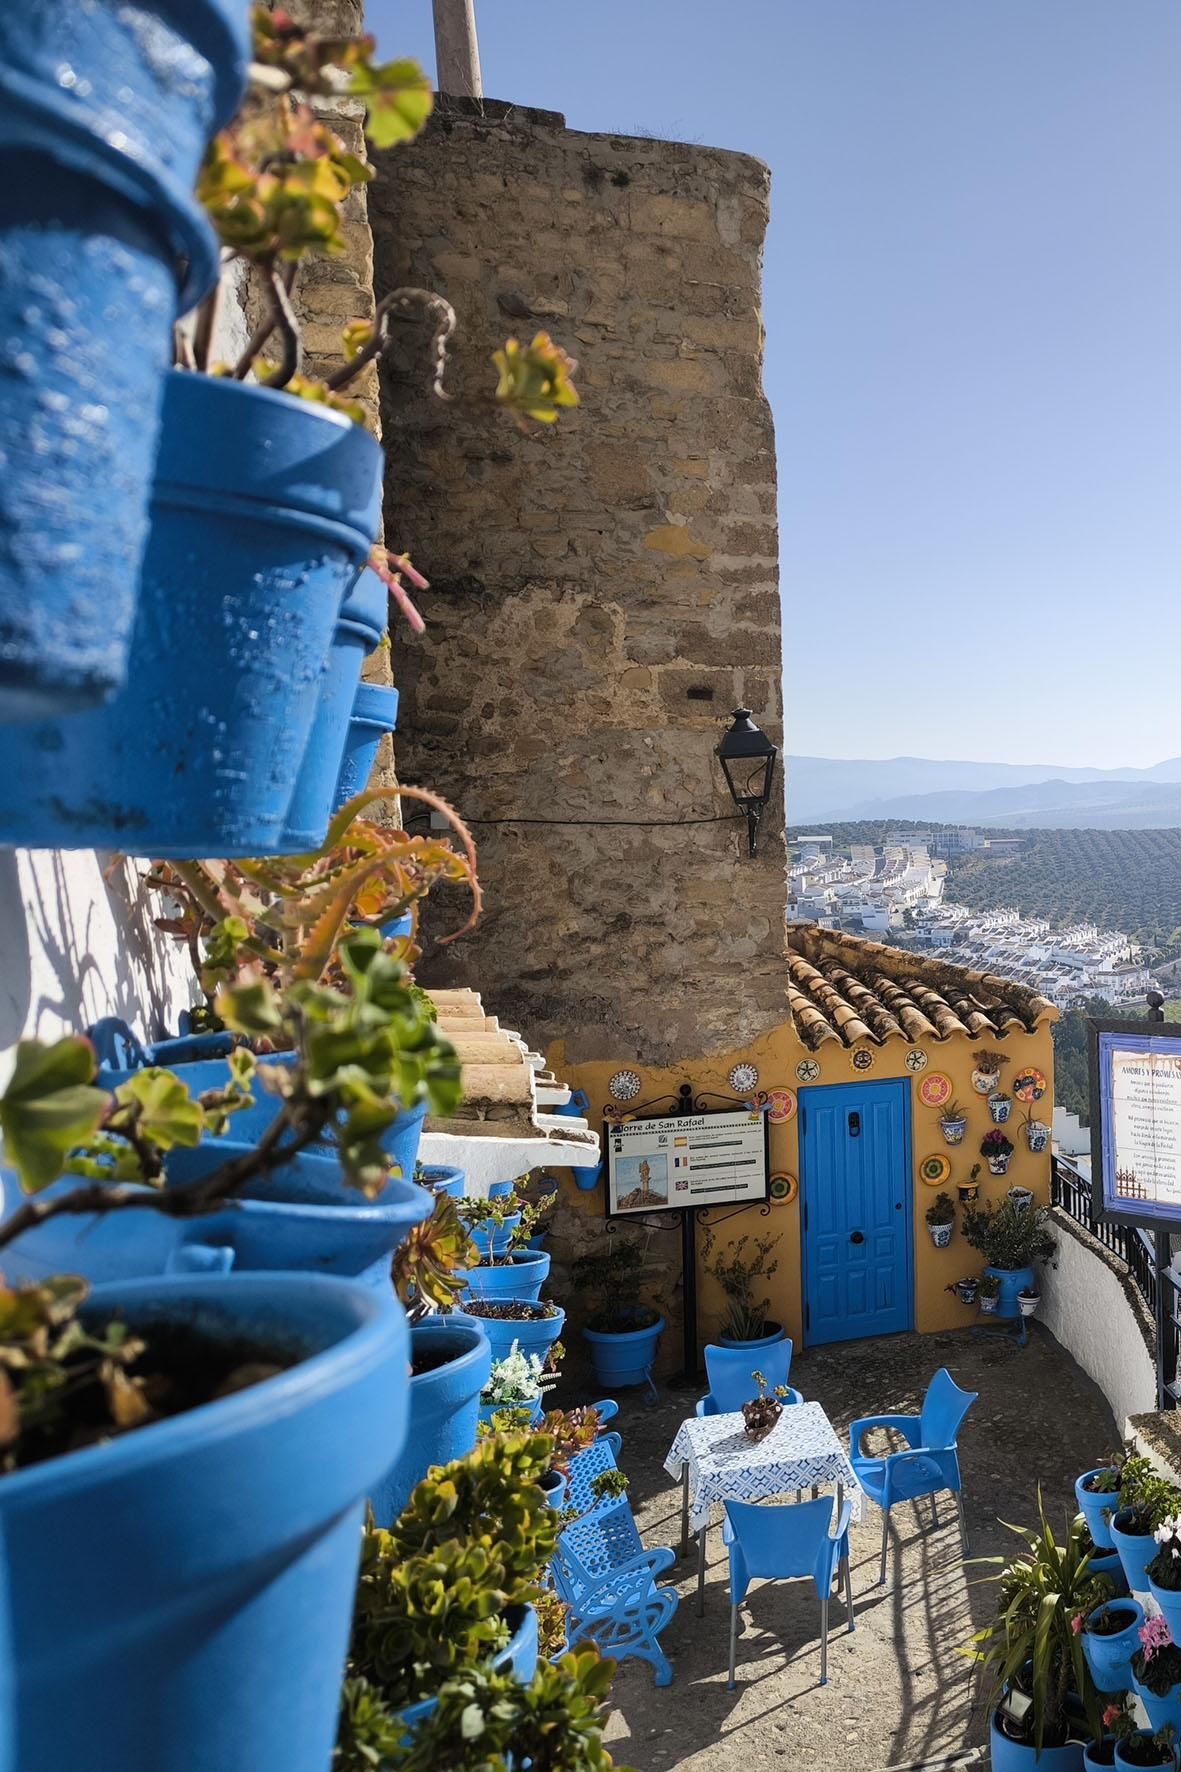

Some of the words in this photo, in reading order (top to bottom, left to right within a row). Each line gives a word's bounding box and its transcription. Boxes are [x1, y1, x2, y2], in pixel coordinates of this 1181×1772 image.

[1122, 1066, 1145, 1077] AMORES
[1146, 1068, 1150, 1077] Y
[645, 1122, 656, 1130] de
[658, 1121, 675, 1129] San
[677, 1117, 705, 1128] Rafael
